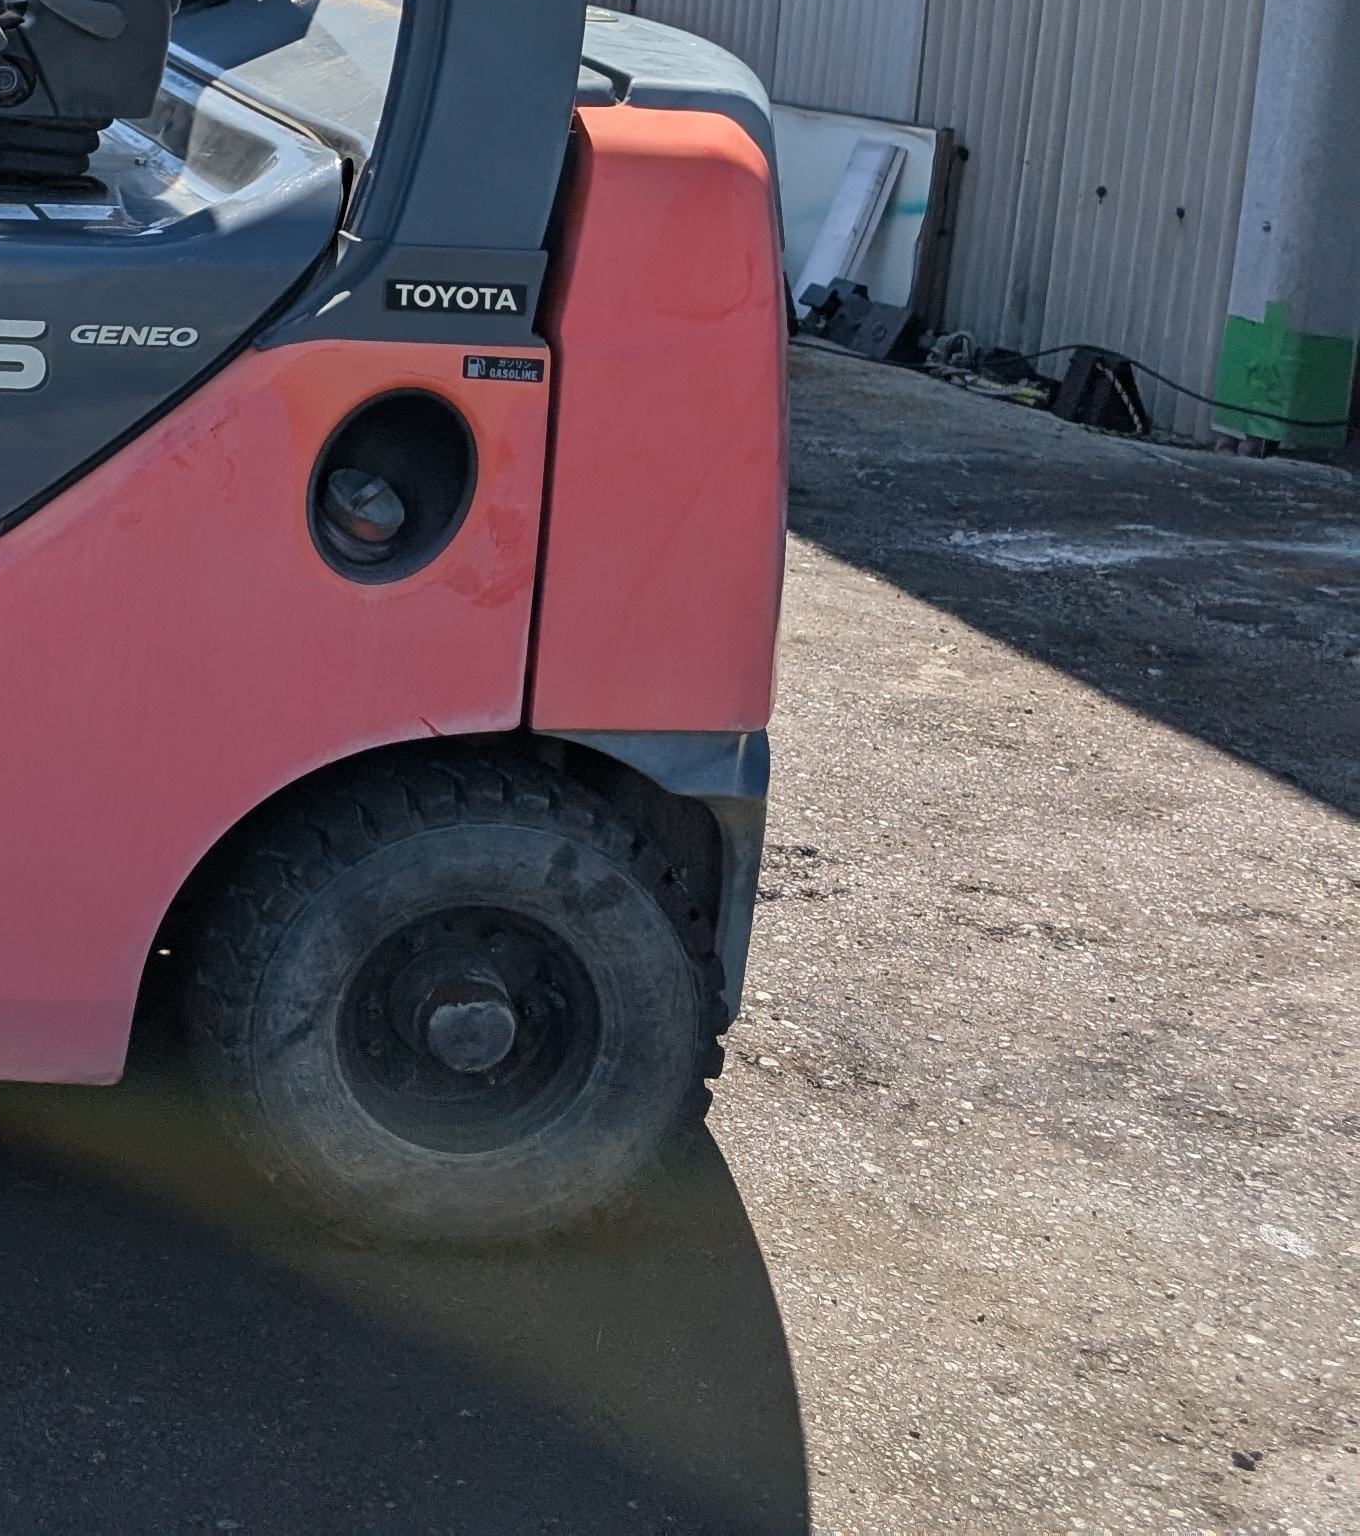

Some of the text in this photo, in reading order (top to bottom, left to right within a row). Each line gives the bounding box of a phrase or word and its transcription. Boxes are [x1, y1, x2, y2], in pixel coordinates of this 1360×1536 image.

[395, 282, 519, 313] TOYOTA
[69, 324, 200, 347] GENEO
[498, 359, 532, 369] ガソリン
[489, 368, 538, 381] GASOLINE
